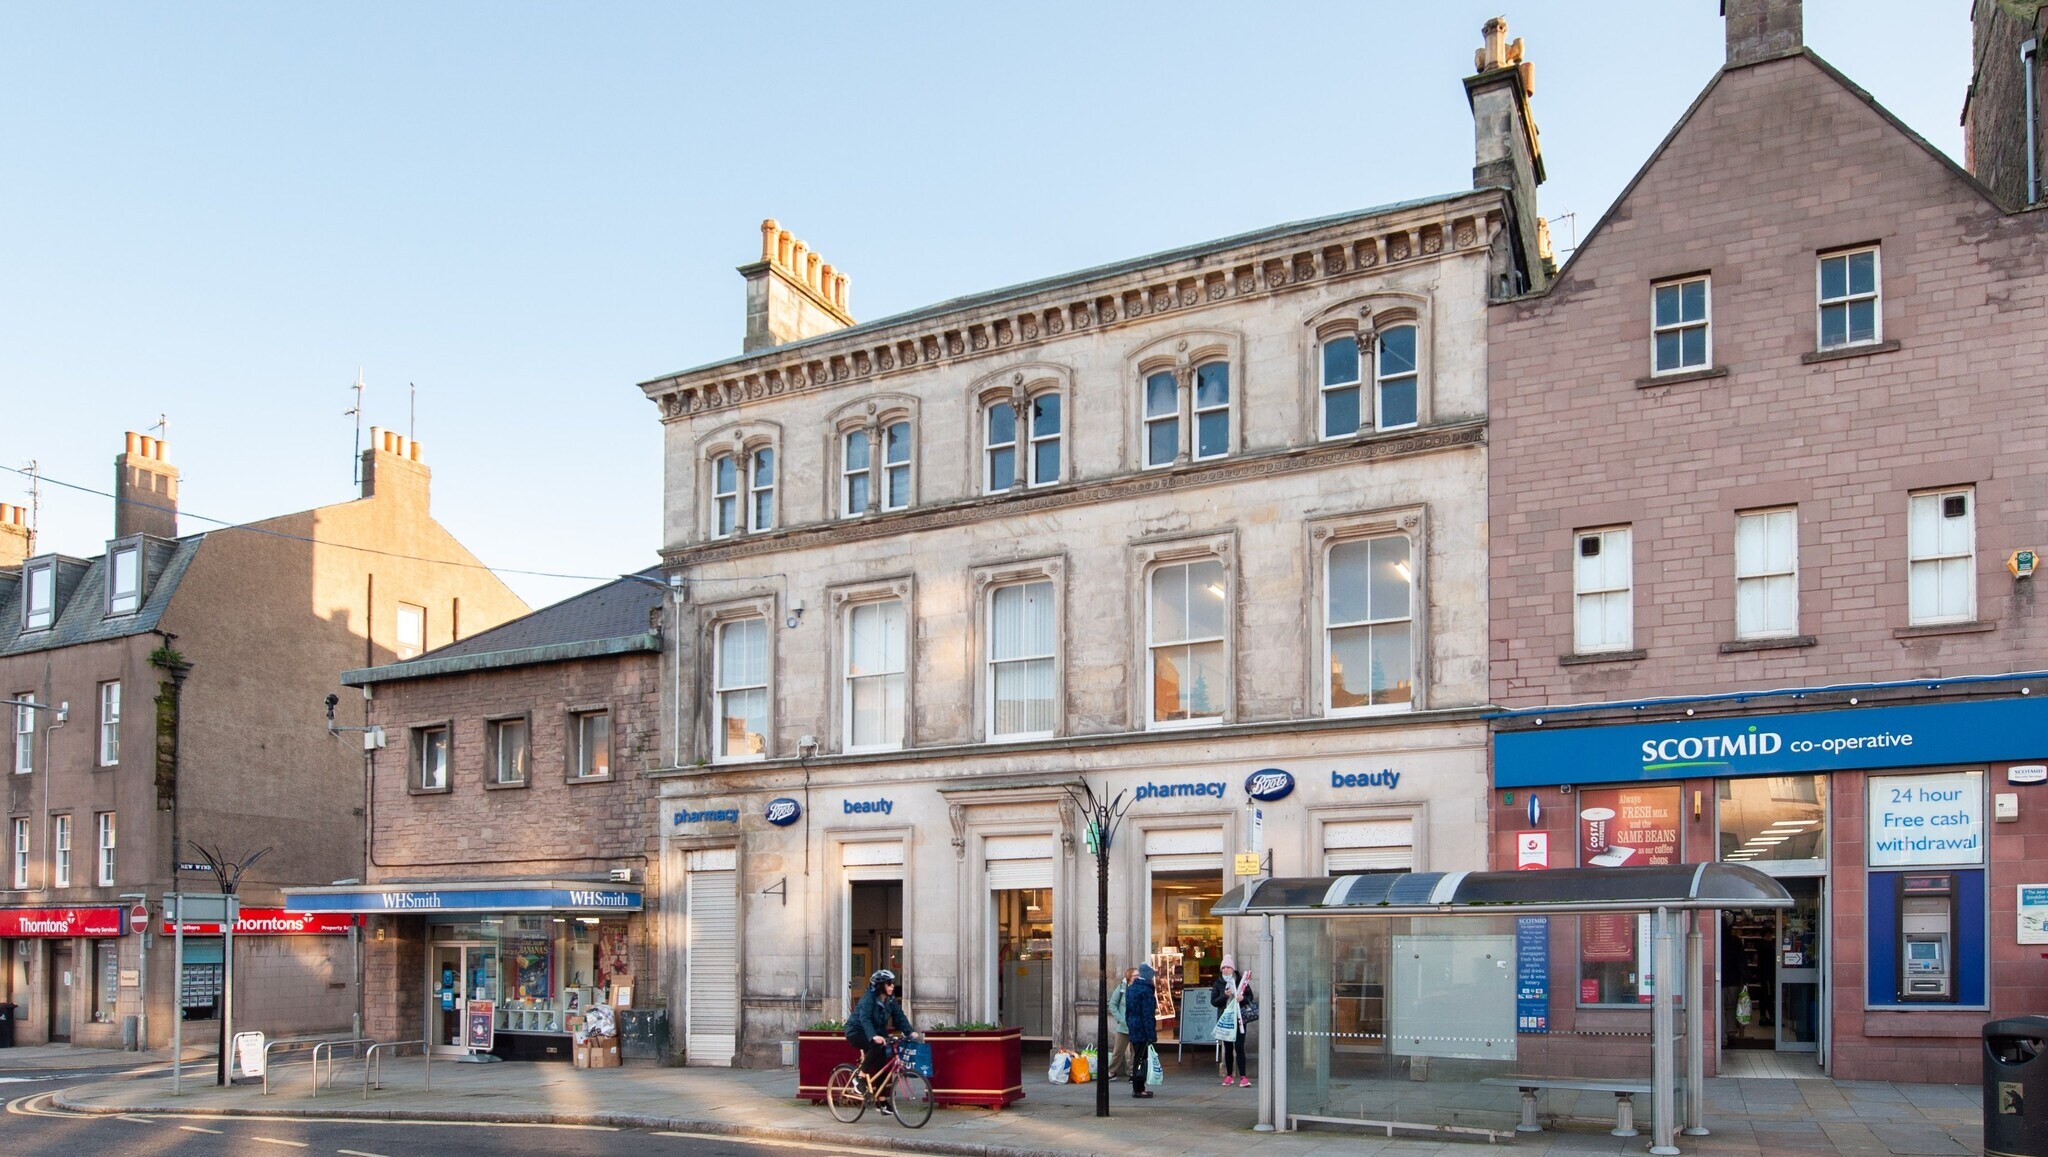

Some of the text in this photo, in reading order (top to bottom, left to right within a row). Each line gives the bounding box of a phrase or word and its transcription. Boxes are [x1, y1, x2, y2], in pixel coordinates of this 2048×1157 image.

[1642, 726, 1913, 762] SCOTMID co-operative
[1251, 773, 1288, 795] Boots
[1331, 768, 1401, 790] beauty
[1136, 781, 1227, 801] pharmacy
[1891, 788, 1963, 803] 24 hour
[843, 798, 894, 815] beauty
[1619, 795, 1641, 805] Always
[674, 808, 739, 826] pharmacy
[768, 802, 796, 821] Boots
[1622, 806, 1668, 818] FRESH MILK
[1884, 810, 1970, 828] Free cash
[1630, 820, 1651, 828] and the
[1590, 821, 1599, 848] COSTA
[1617, 830, 1676, 843] SAME BEANS
[1654, 844, 1673, 854] coffee
[1877, 834, 1977, 852] withdrawal
[1649, 855, 1668, 865] shops
[382, 893, 441, 909] WHSmith
[570, 891, 629, 907] WHSmith
[19, 917, 68, 933] Thorntons
